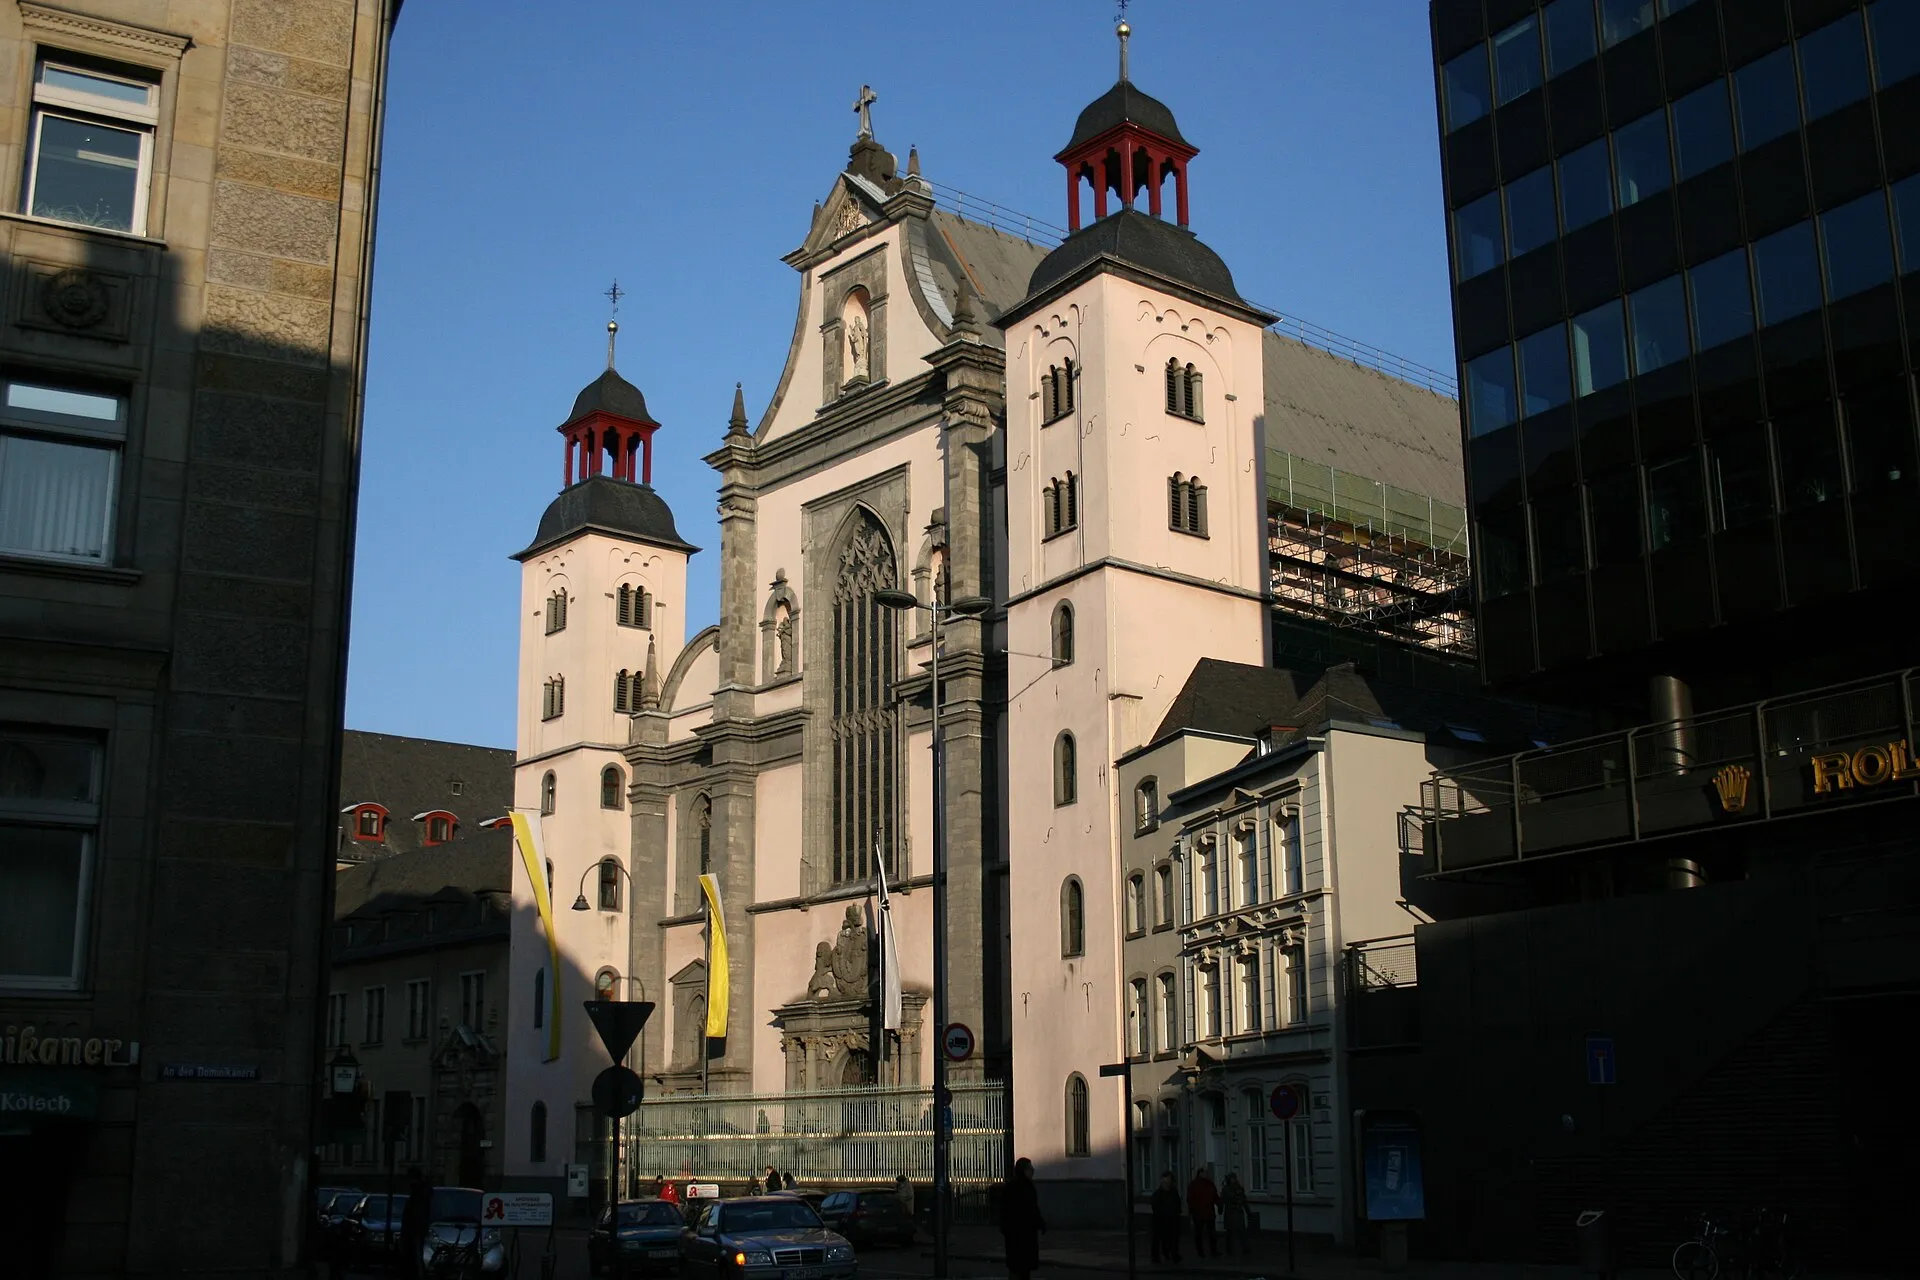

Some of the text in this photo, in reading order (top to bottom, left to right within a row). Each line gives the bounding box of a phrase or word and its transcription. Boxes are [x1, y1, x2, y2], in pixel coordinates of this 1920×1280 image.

[1811, 738, 1920, 794] ROL
[0, 1025, 123, 1067] ikaner
[163, 1064, 256, 1078] An den Dominikanern
[0, 1090, 72, 1114] Kölsch
